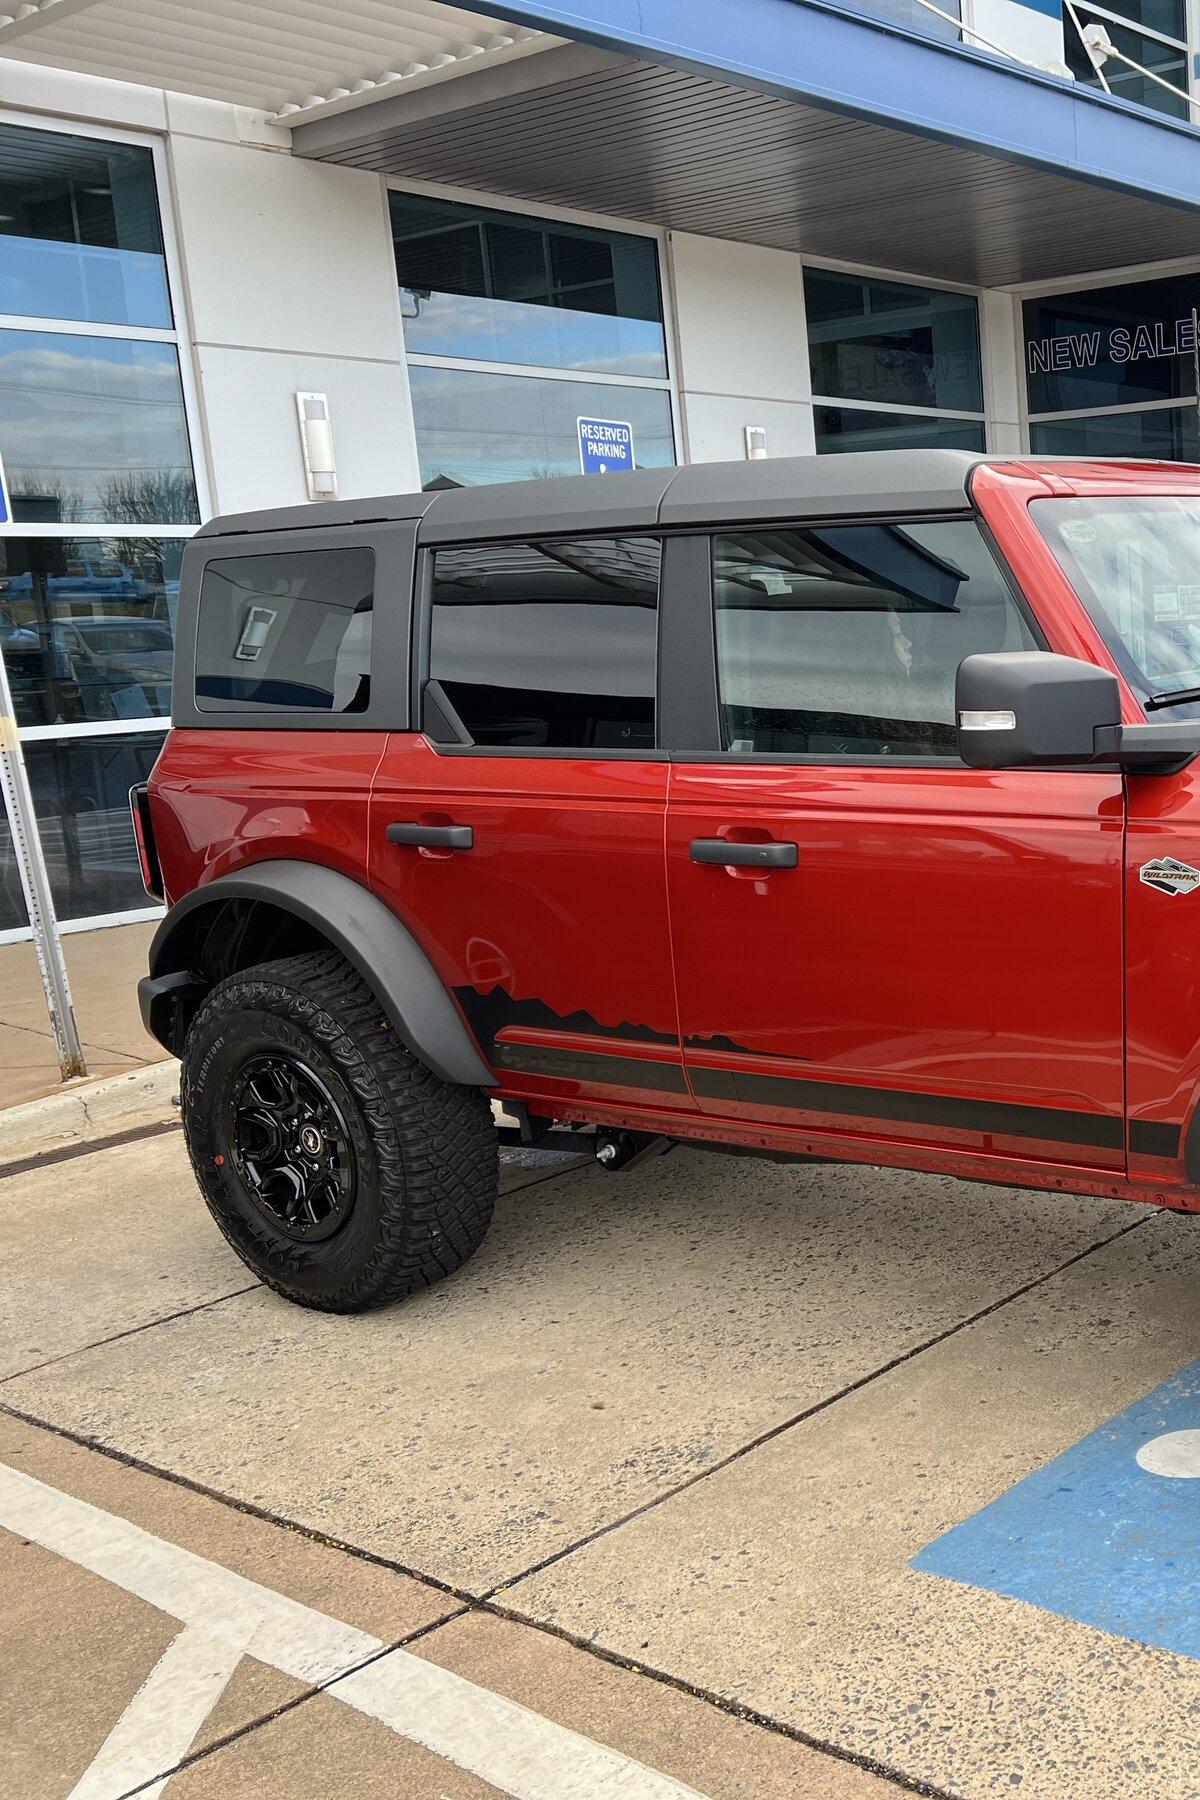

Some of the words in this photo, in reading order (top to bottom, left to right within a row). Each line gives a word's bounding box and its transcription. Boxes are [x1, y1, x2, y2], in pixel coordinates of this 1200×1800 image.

[1028, 332, 1100, 374] NEW
[581, 424, 629, 442] RESERVED
[587, 441, 626, 459] PARKING
[197, 1036, 225, 1094] TERRITORY
